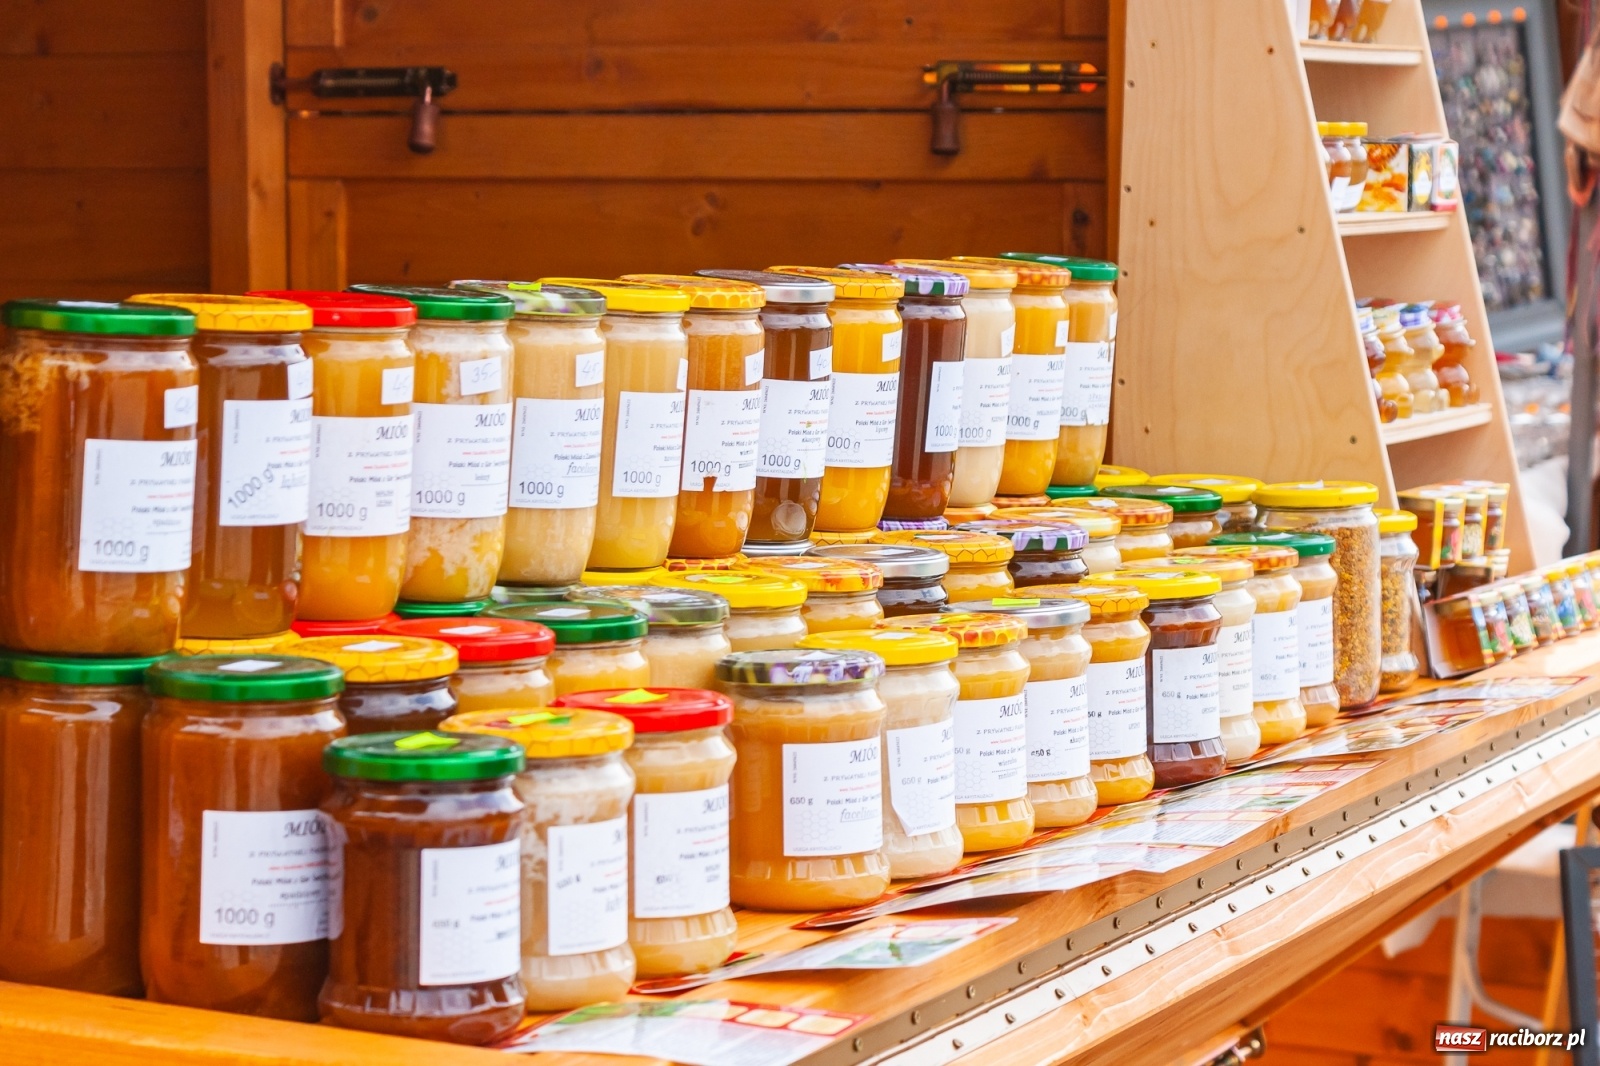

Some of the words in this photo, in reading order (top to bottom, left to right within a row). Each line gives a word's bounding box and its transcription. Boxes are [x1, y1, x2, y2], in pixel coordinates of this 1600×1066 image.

[474, 408, 506, 428] MIÓD
[1006, 414, 1030, 428] 1000
[934, 424, 954, 437] 1000
[959, 426, 984, 439] 1000
[827, 436, 851, 450] 000
[853, 441, 861, 454] g
[690, 460, 721, 474] 1000
[724, 464, 732, 476] g
[762, 453, 791, 468] 1000
[623, 470, 652, 484] 1000
[226, 476, 262, 508] 1000
[262, 468, 274, 484] g
[518, 481, 553, 495] 1000
[556, 484, 564, 498] g
[415, 490, 454, 504] 1000
[457, 492, 466, 506] g
[316, 502, 355, 518] 1000
[358, 506, 368, 522] g
[94, 540, 136, 558] 1000
[140, 544, 150, 562] g
[1088, 710, 1096, 718] 50
[954, 747, 964, 755] 50
[901, 776, 916, 786] 650
[790, 796, 806, 805] 650
[214, 908, 259, 925] 1000
[264, 911, 276, 928] g
